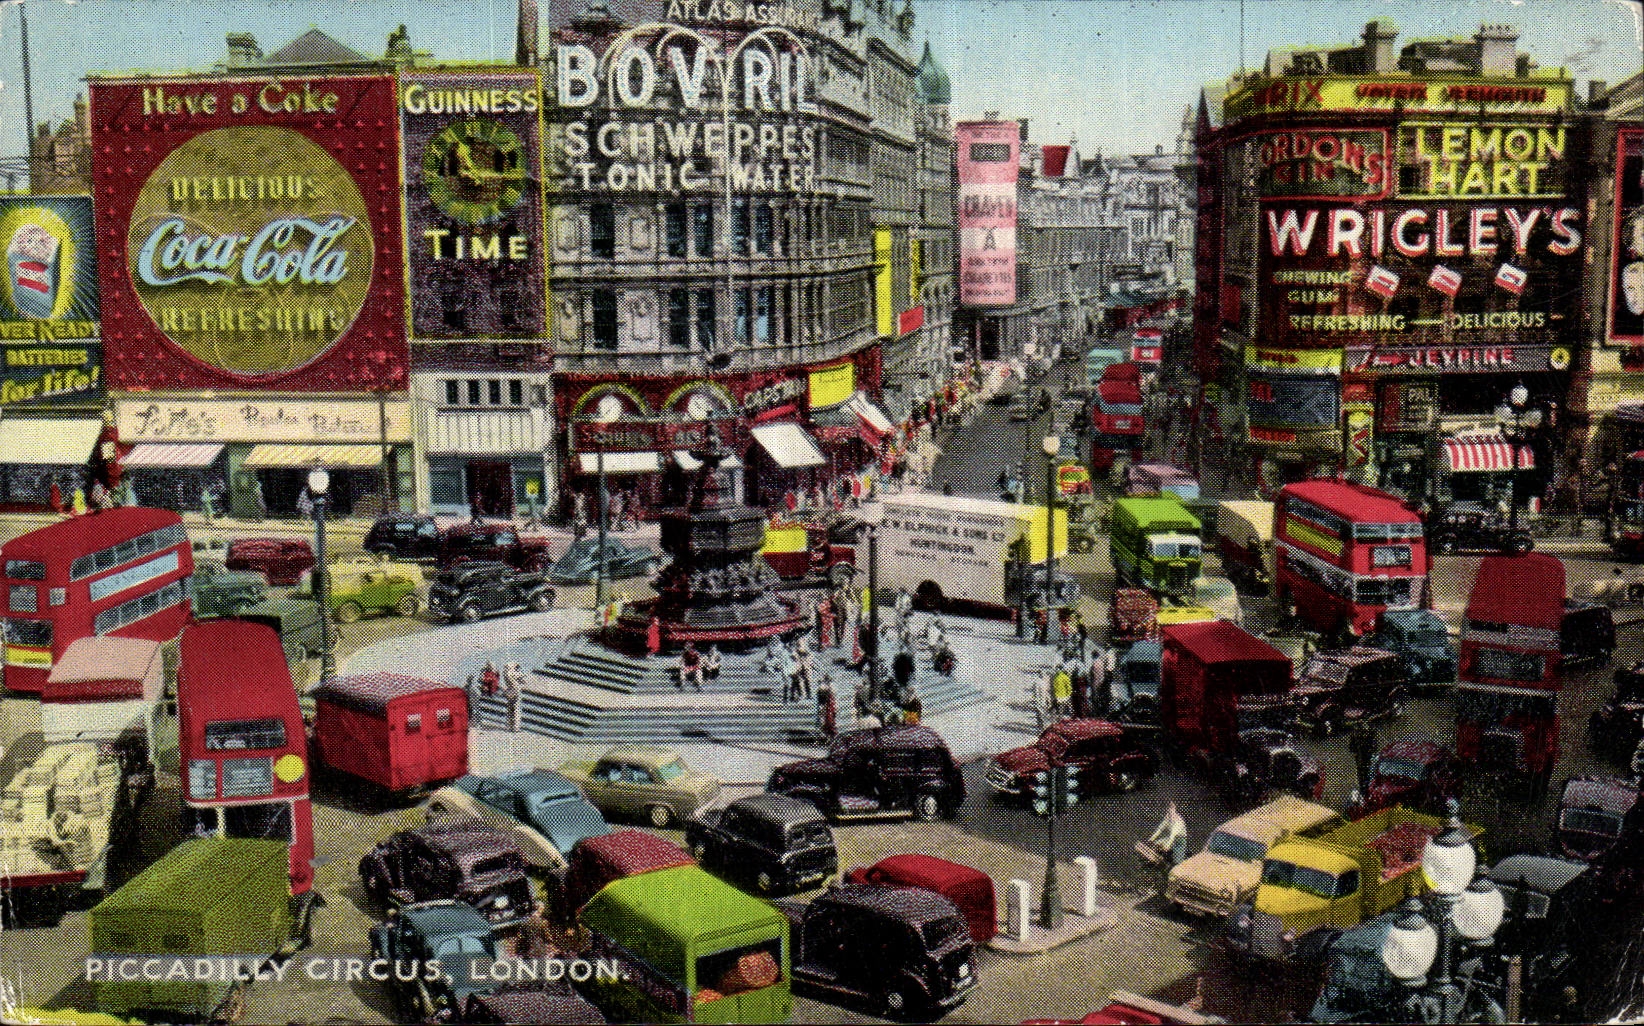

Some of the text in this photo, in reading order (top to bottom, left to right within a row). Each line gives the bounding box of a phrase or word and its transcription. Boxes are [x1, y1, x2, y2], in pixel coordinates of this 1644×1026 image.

[667, 0, 735, 20] ATLAS
[557, 43, 820, 113] BOVRIL
[142, 83, 340, 116] Have a Coke
[404, 84, 538, 114] GUINNESS
[564, 119, 817, 161] SCHWEPPES
[1414, 126, 1566, 161] LEMON
[575, 162, 818, 193] TONIC WATER
[1275, 160, 1335, 184] GIN
[1428, 161, 1549, 196] HART
[171, 175, 321, 200] DELICIOUS
[425, 229, 528, 260] TIME
[1266, 207, 1583, 258] WRIGLEY'S
[138, 216, 358, 287] Coca-Cola
[1272, 269, 1352, 286] CHEWING
[1287, 289, 1340, 305] GUM
[161, 305, 347, 332] REFRESHING
[1289, 312, 1546, 332] REFRESHING DELICIOUS
[7, 348, 88, 366] BATTERIES
[1409, 347, 1517, 367] JEYPINE
[0, 365, 100, 404] for life!
